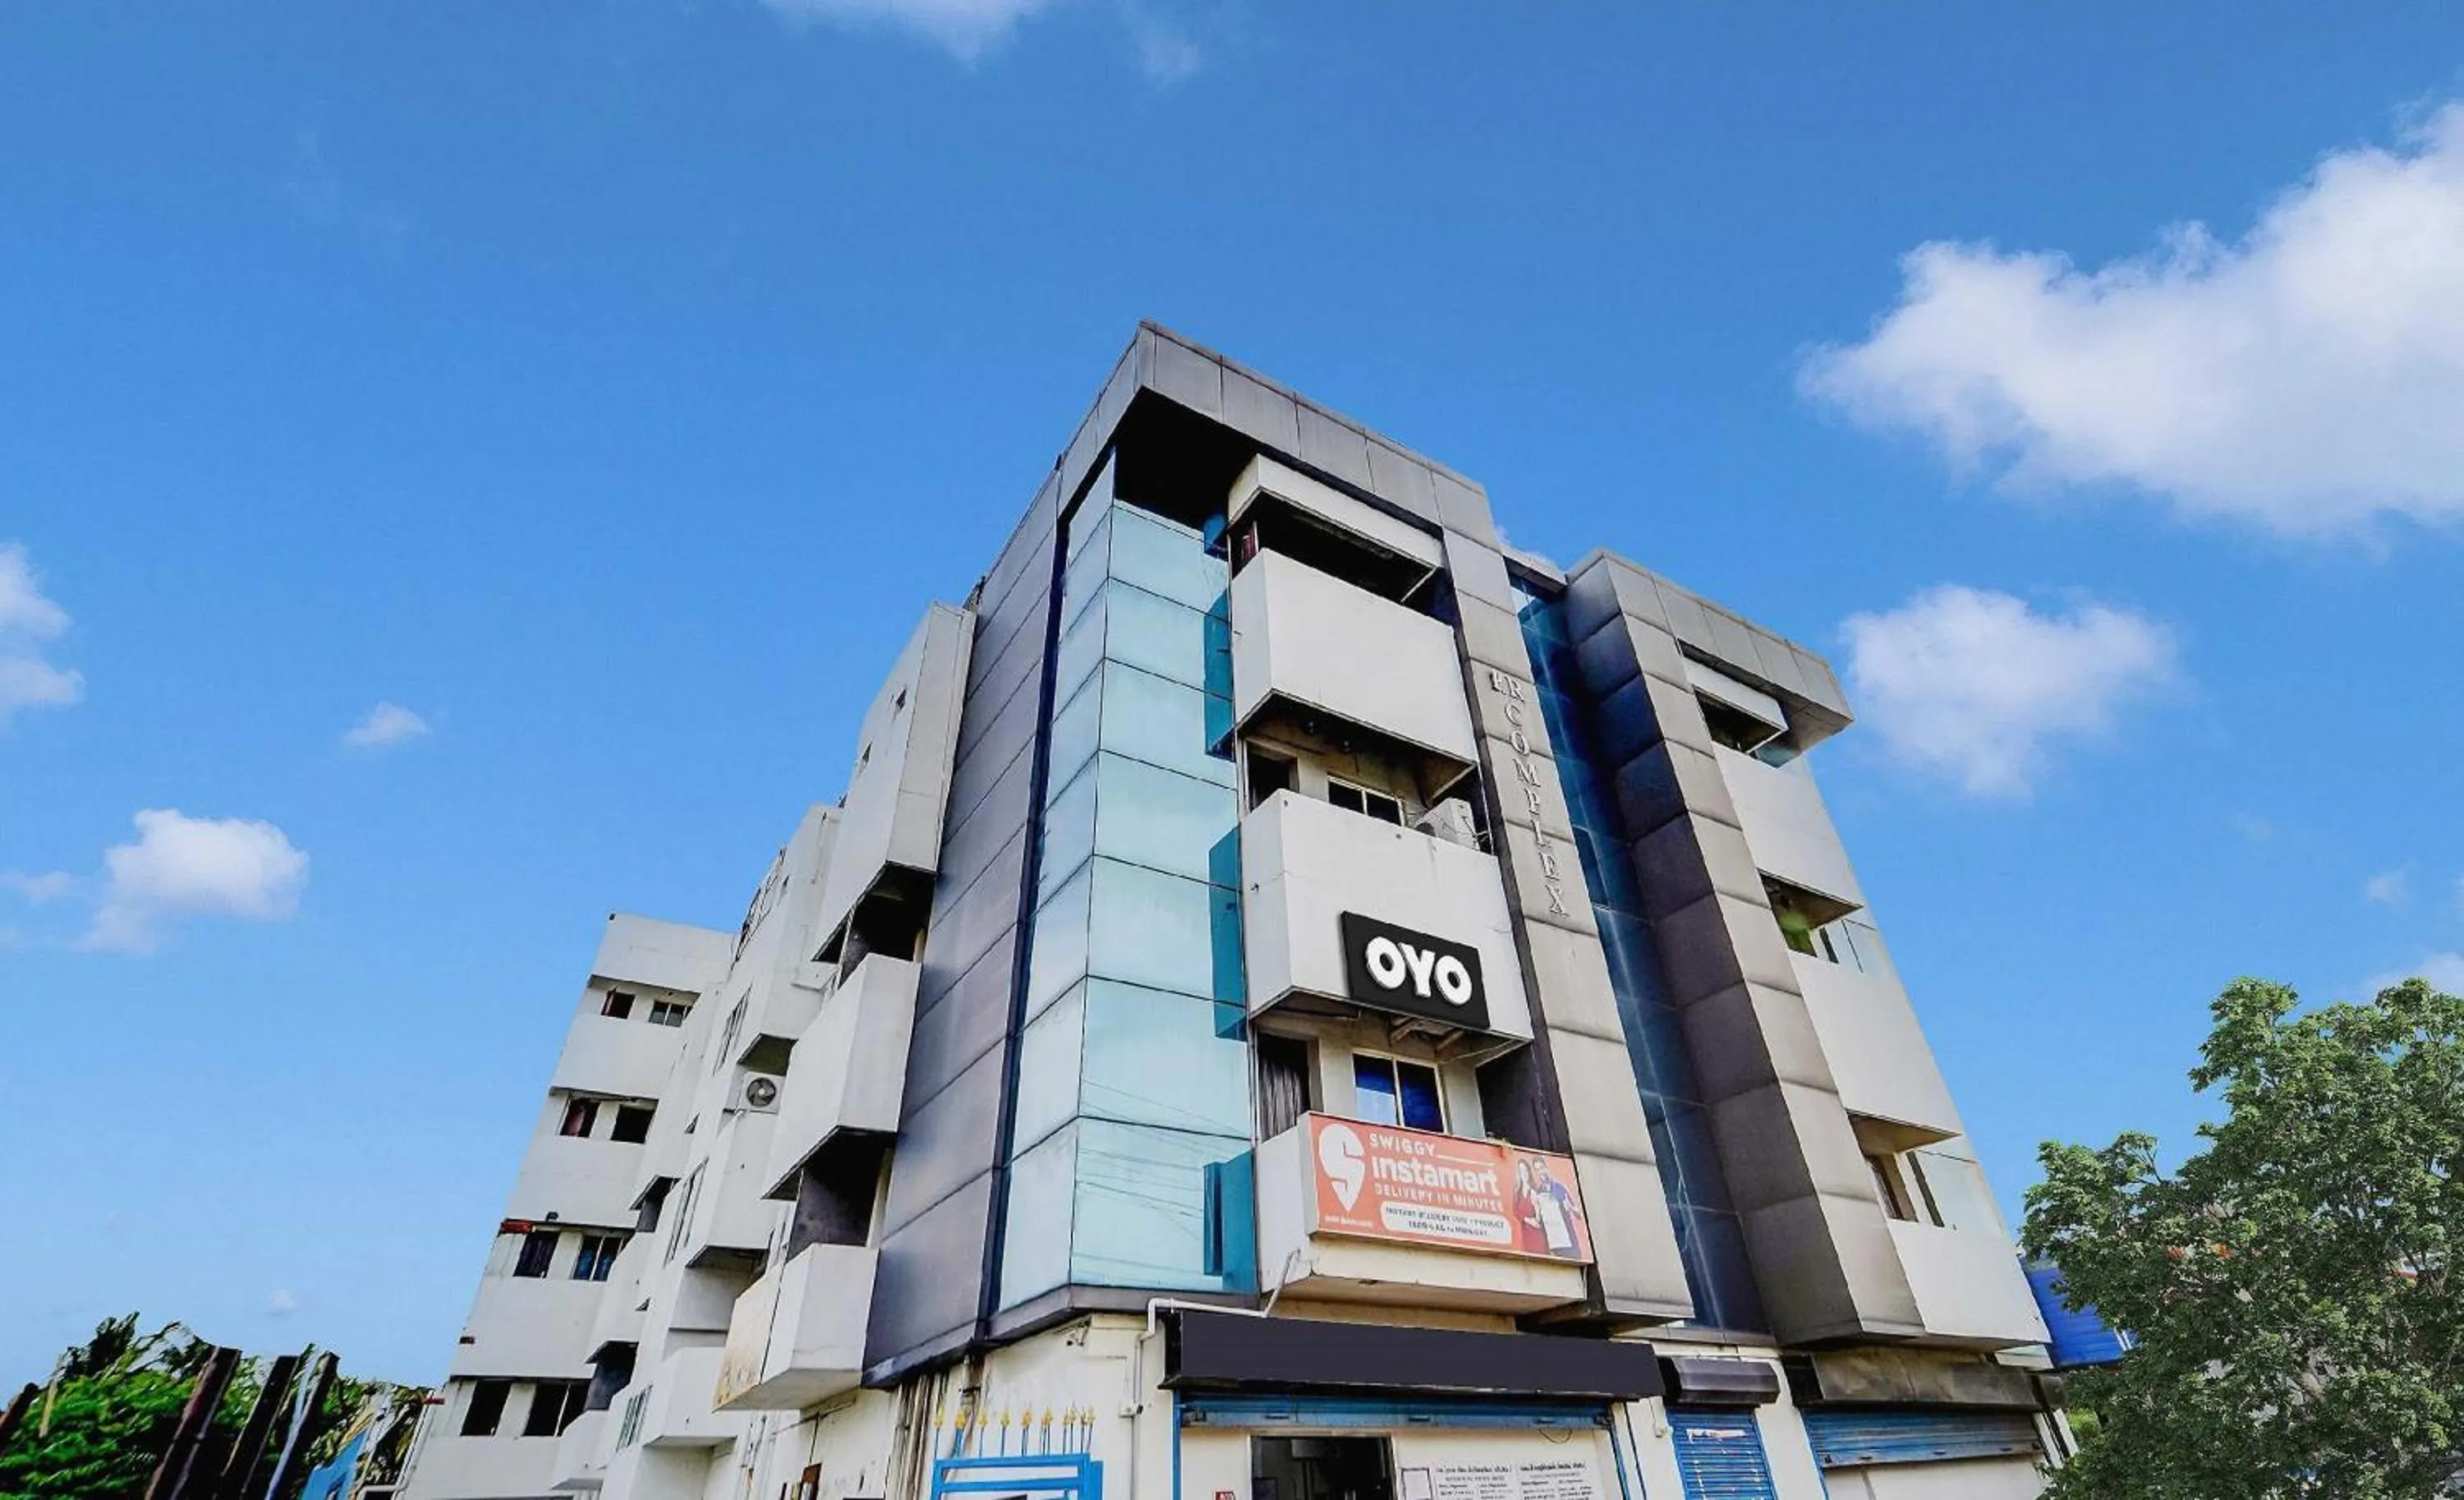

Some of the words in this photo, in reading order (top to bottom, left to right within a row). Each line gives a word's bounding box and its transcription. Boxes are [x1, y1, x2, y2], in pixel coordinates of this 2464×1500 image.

[1505, 702, 1570, 918] COMPLEX
[1365, 936, 1473, 1005] OYO
[1369, 1133, 1435, 1157] SWIGGY
[1372, 1155, 1501, 1197] instamart
[1374, 1184, 1432, 1203] DELIVERY
[1437, 1193, 1451, 1205] IN
